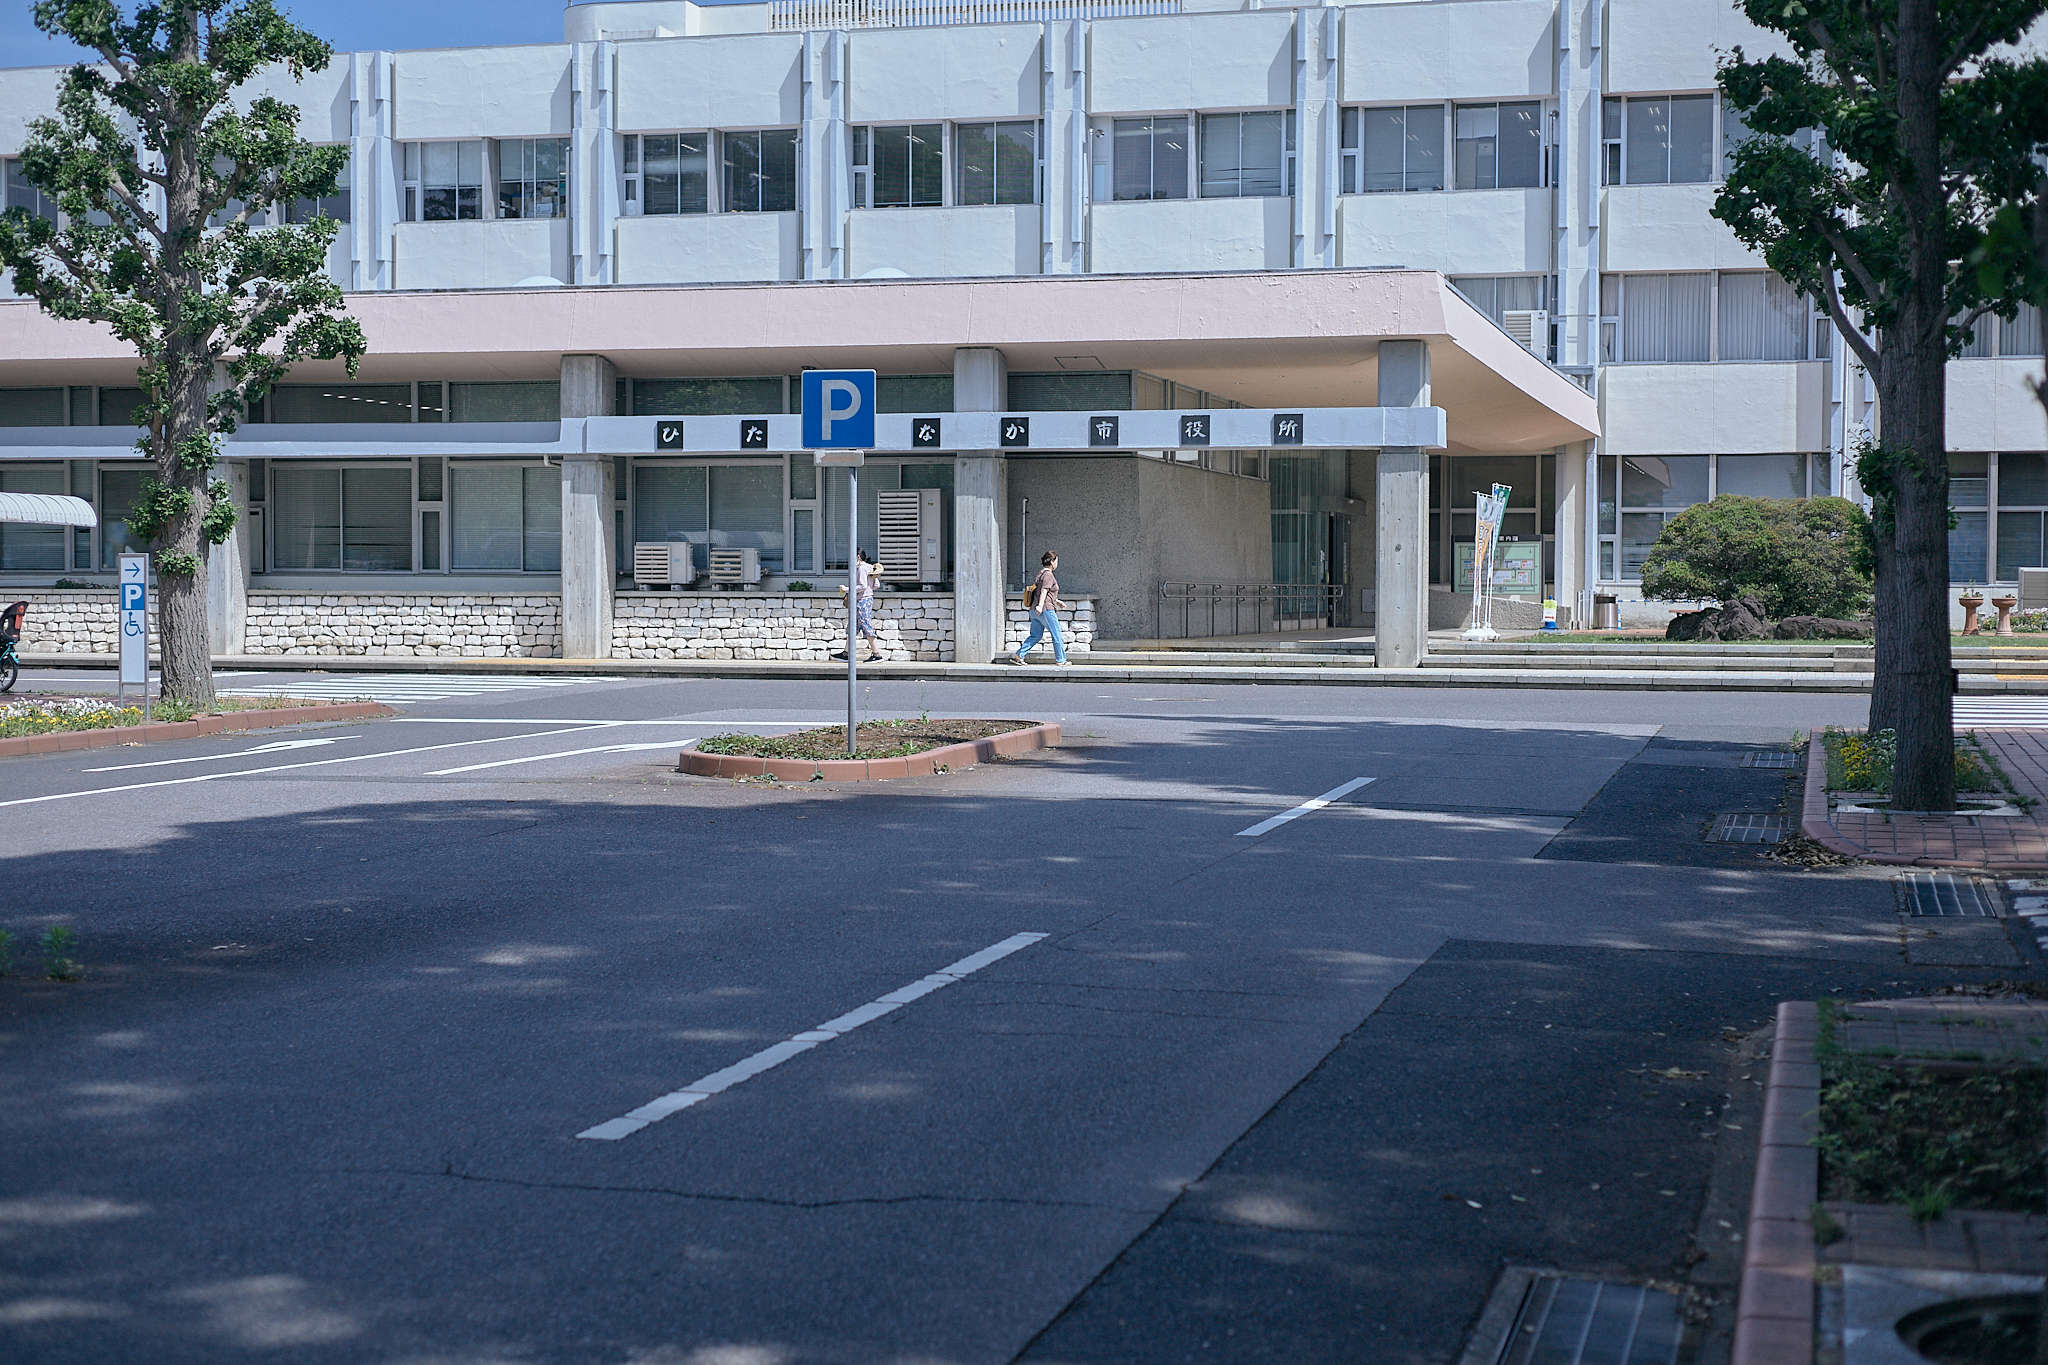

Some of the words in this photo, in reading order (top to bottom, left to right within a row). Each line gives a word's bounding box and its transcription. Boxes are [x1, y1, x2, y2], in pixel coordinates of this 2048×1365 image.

[822, 380, 861, 440] P
[662, 419, 1298, 443] ひたなか市役所
[125, 584, 142, 609] P
